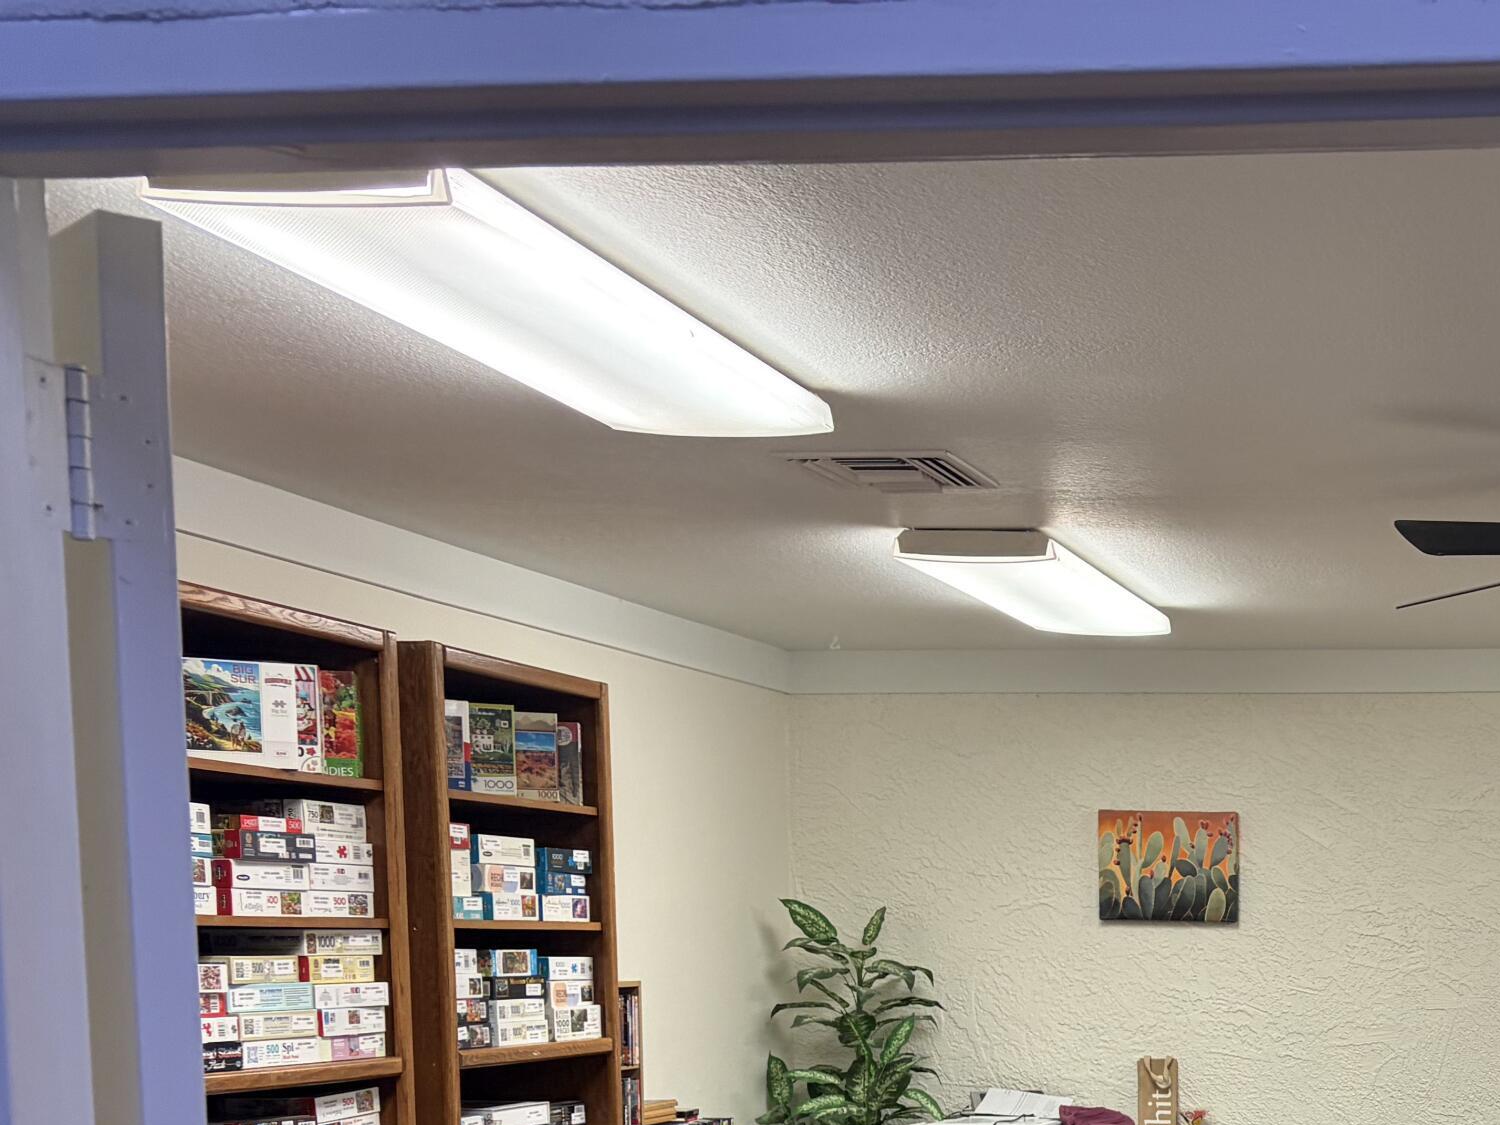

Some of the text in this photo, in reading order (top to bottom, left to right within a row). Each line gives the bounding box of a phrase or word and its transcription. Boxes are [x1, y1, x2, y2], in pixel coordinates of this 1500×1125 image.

[233, 664, 254, 674] BIG
[231, 673, 256, 684] SUR
[484, 779, 514, 789] 1000
[538, 790, 558, 800] 1000
[317, 935, 335, 948] 1000
